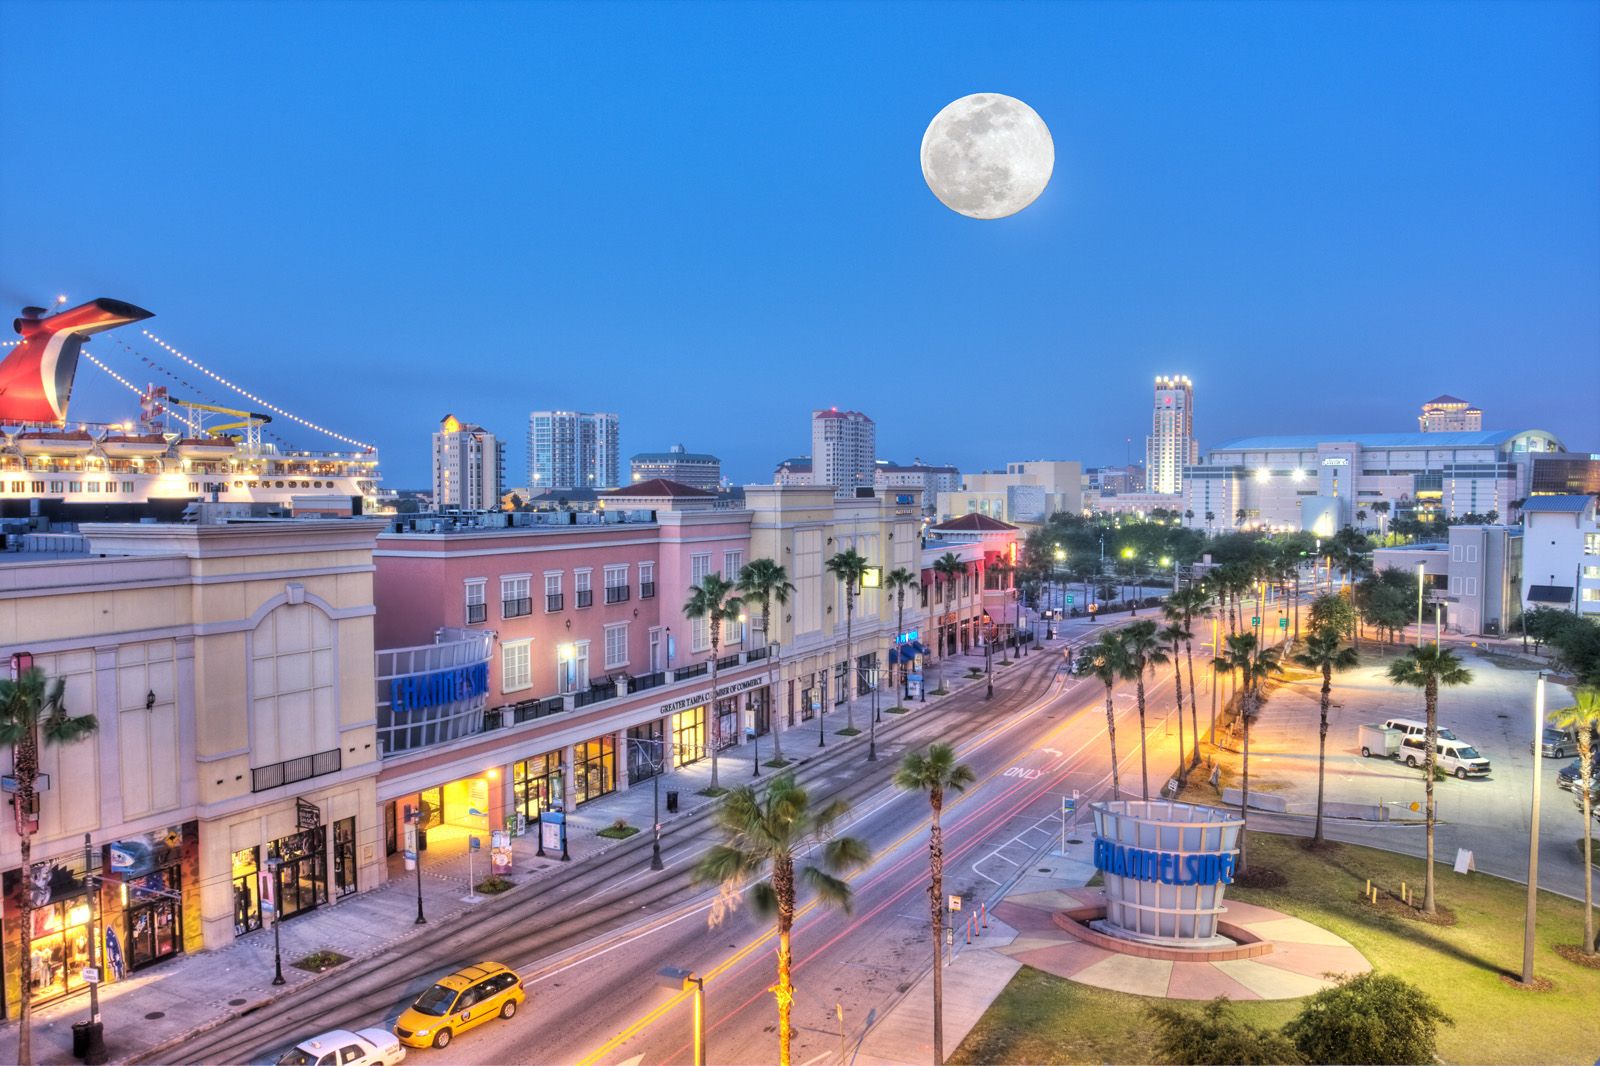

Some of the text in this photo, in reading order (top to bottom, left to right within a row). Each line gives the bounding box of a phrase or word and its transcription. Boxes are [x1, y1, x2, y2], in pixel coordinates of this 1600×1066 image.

[391, 662, 487, 712] CHANNELSID
[660, 677, 762, 714] GREATER TAMPA CMBER OF COMMERCE
[1003, 766, 1044, 780] ONLY
[1094, 837, 1235, 886] CHANNELSIDE
